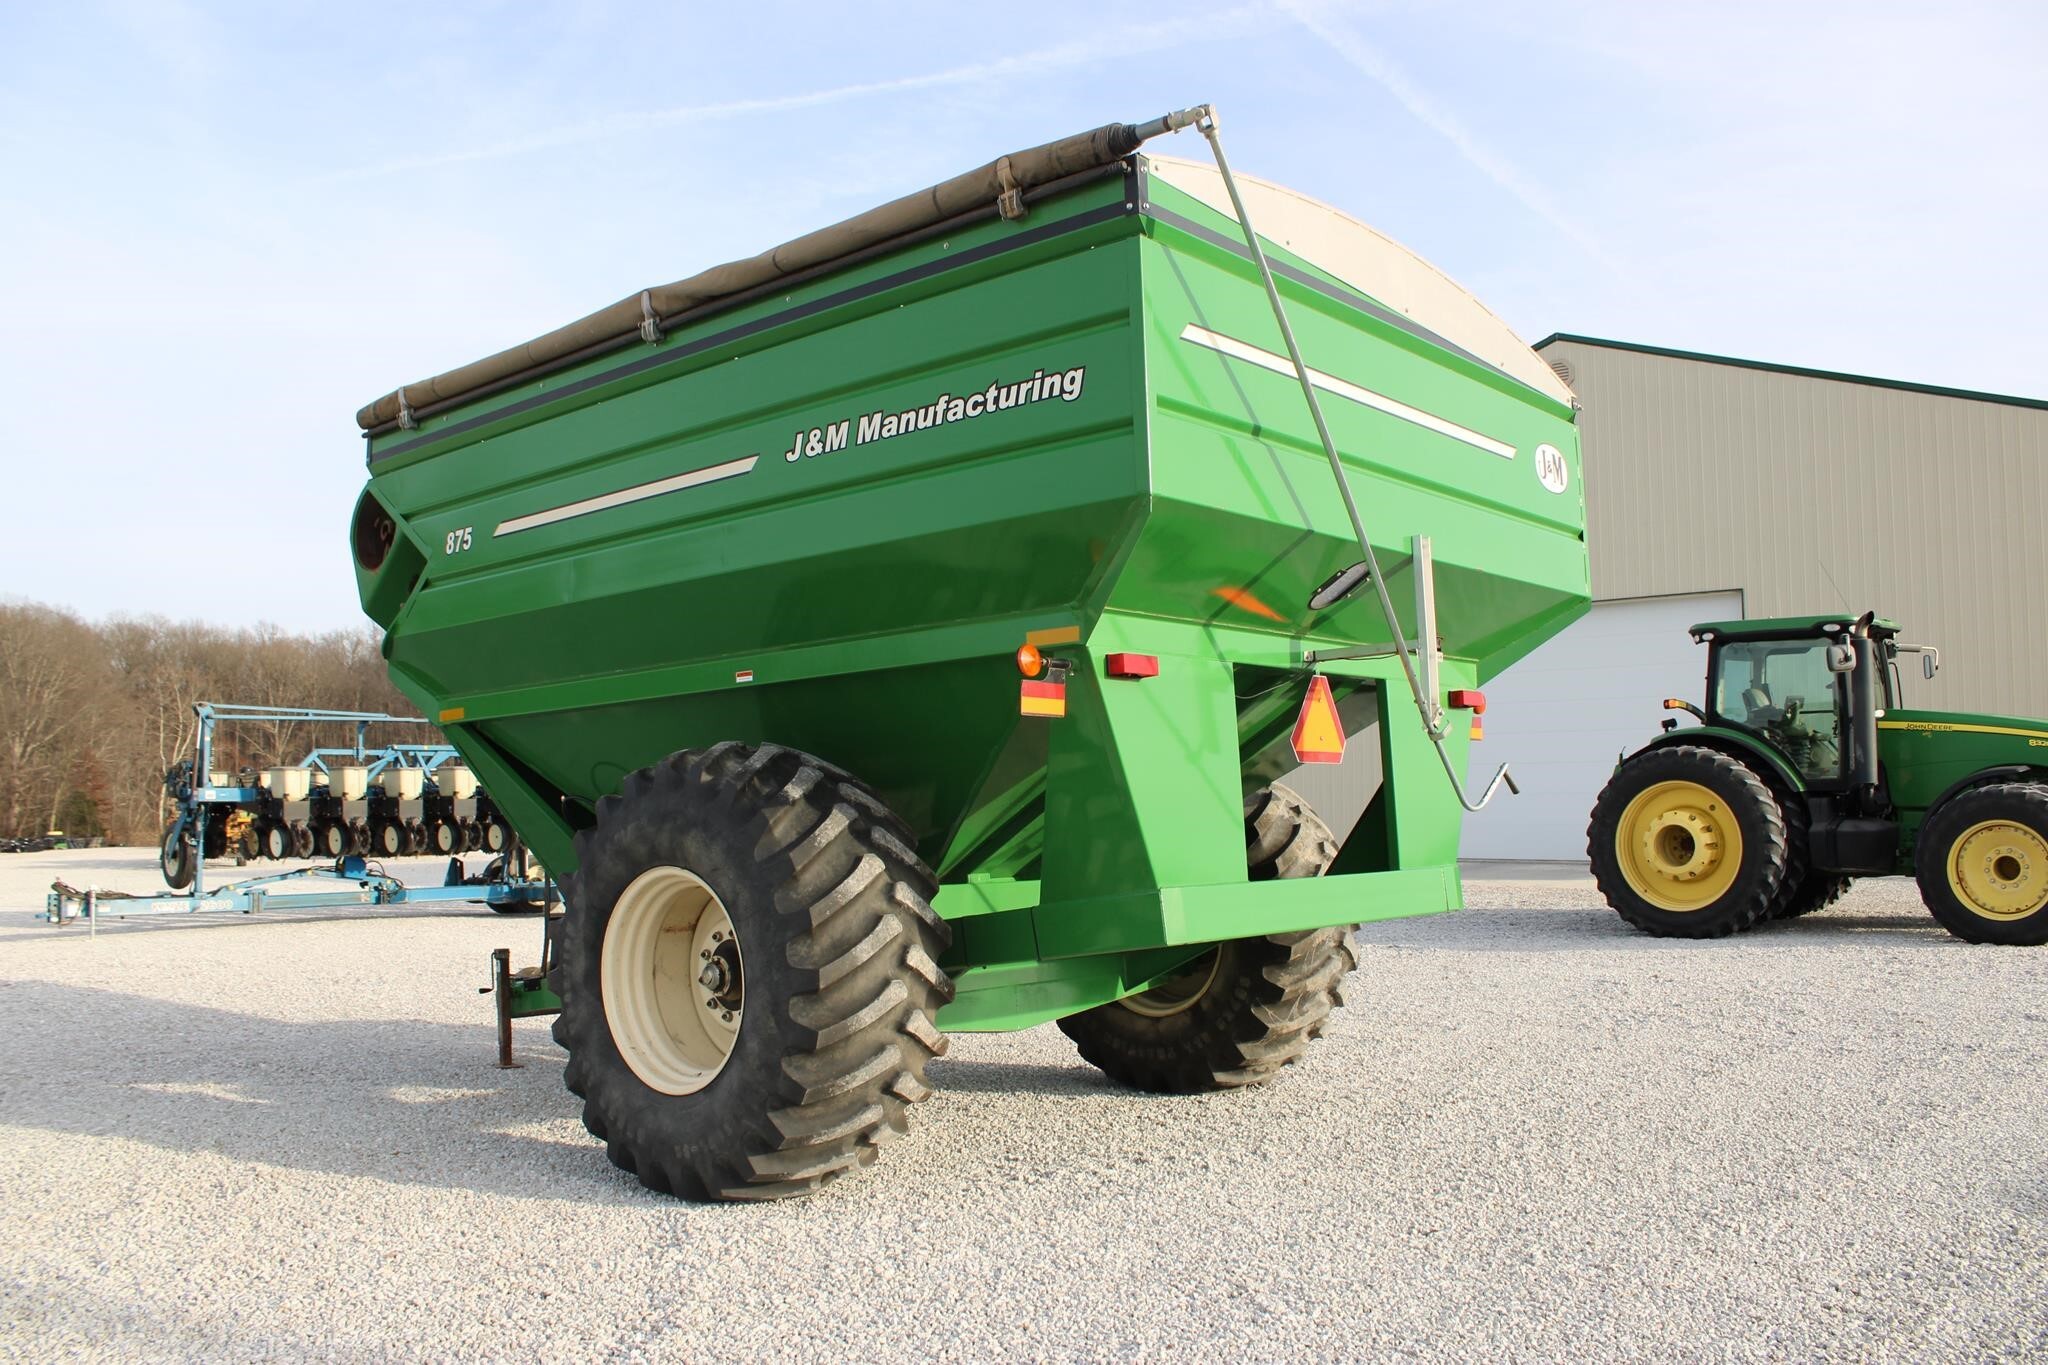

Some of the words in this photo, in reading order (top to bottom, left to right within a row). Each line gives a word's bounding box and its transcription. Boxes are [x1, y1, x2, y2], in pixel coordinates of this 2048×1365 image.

[785, 419, 850, 462] J&M
[856, 365, 1086, 445] Manufacturing
[1538, 449, 1564, 486] J&M
[445, 526, 473, 555] 875
